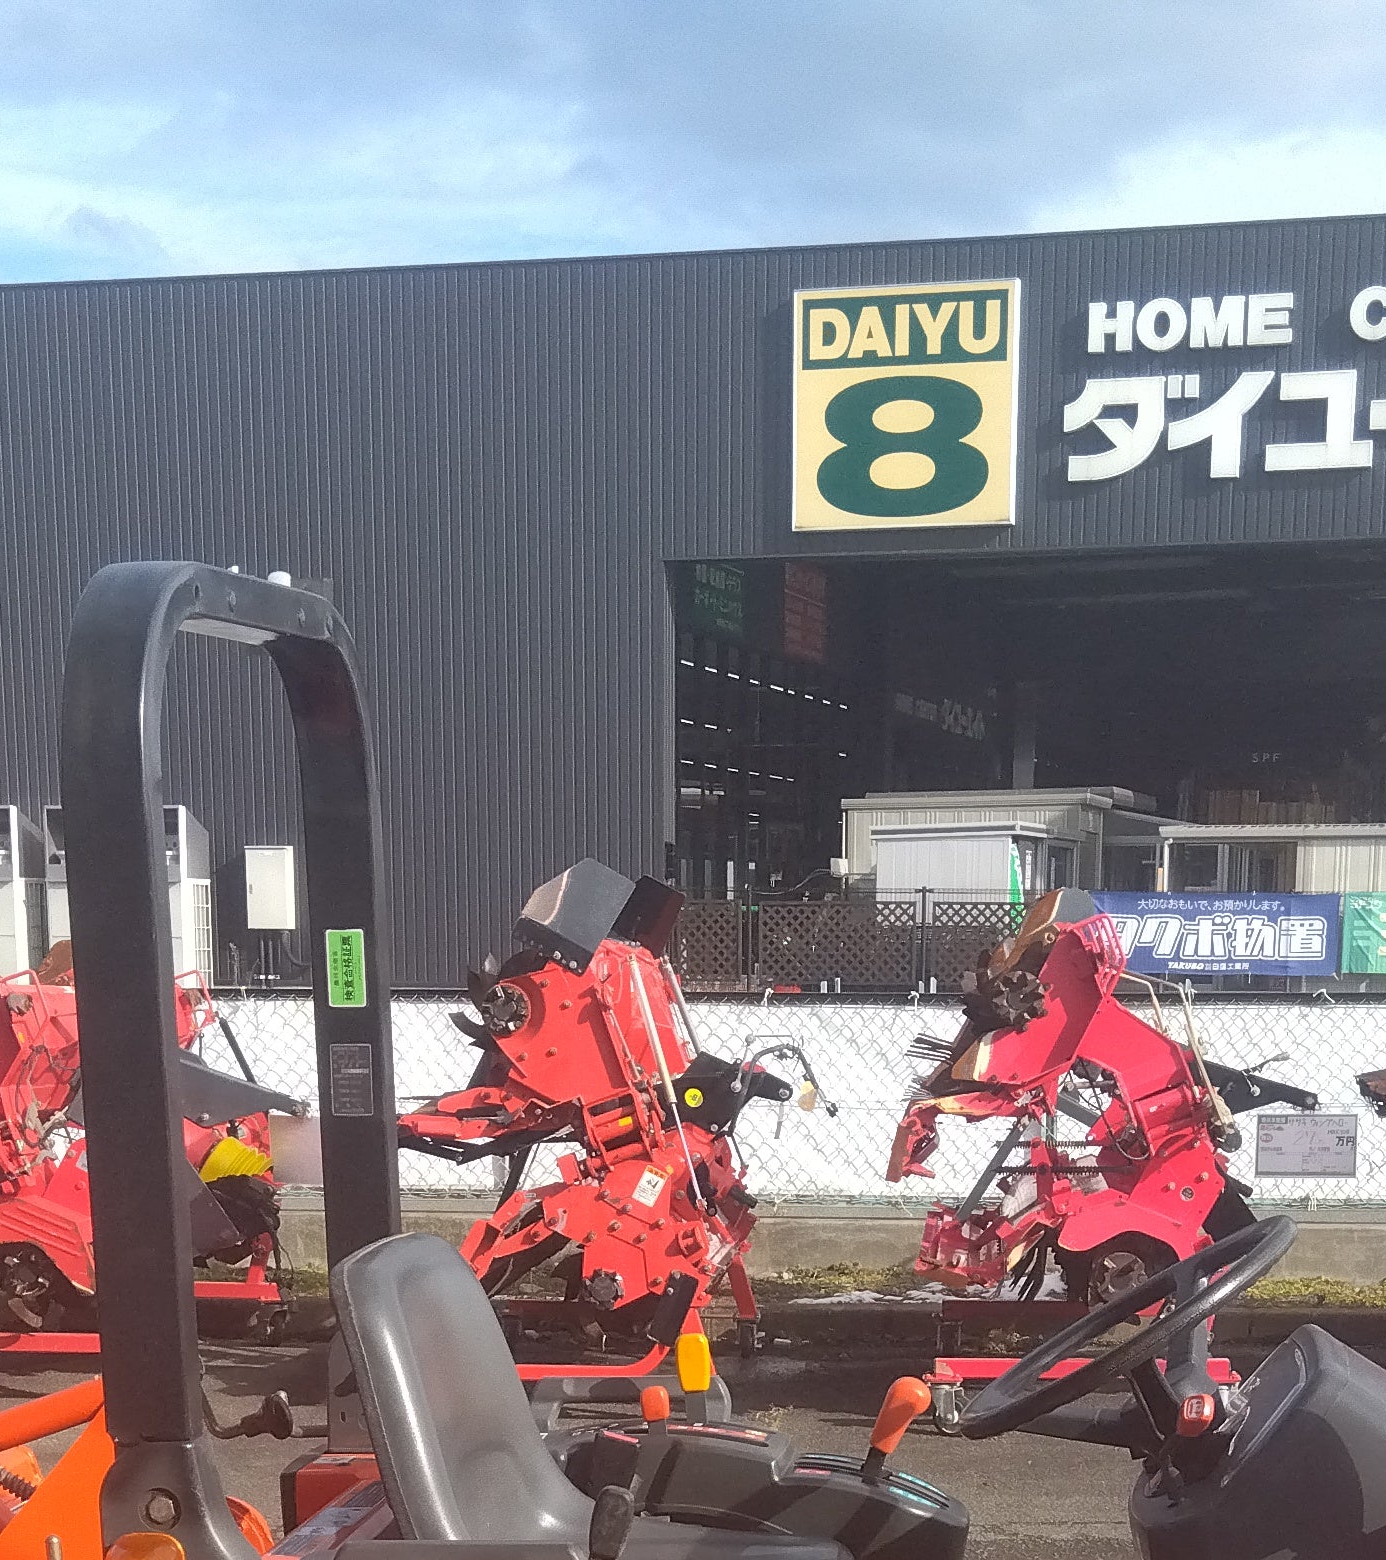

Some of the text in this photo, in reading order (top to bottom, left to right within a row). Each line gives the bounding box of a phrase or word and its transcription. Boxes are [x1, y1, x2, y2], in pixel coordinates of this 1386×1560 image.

[809, 297, 1002, 359] DAIYU
[1088, 292, 1294, 355] HOME
[816, 374, 989, 518] 8
